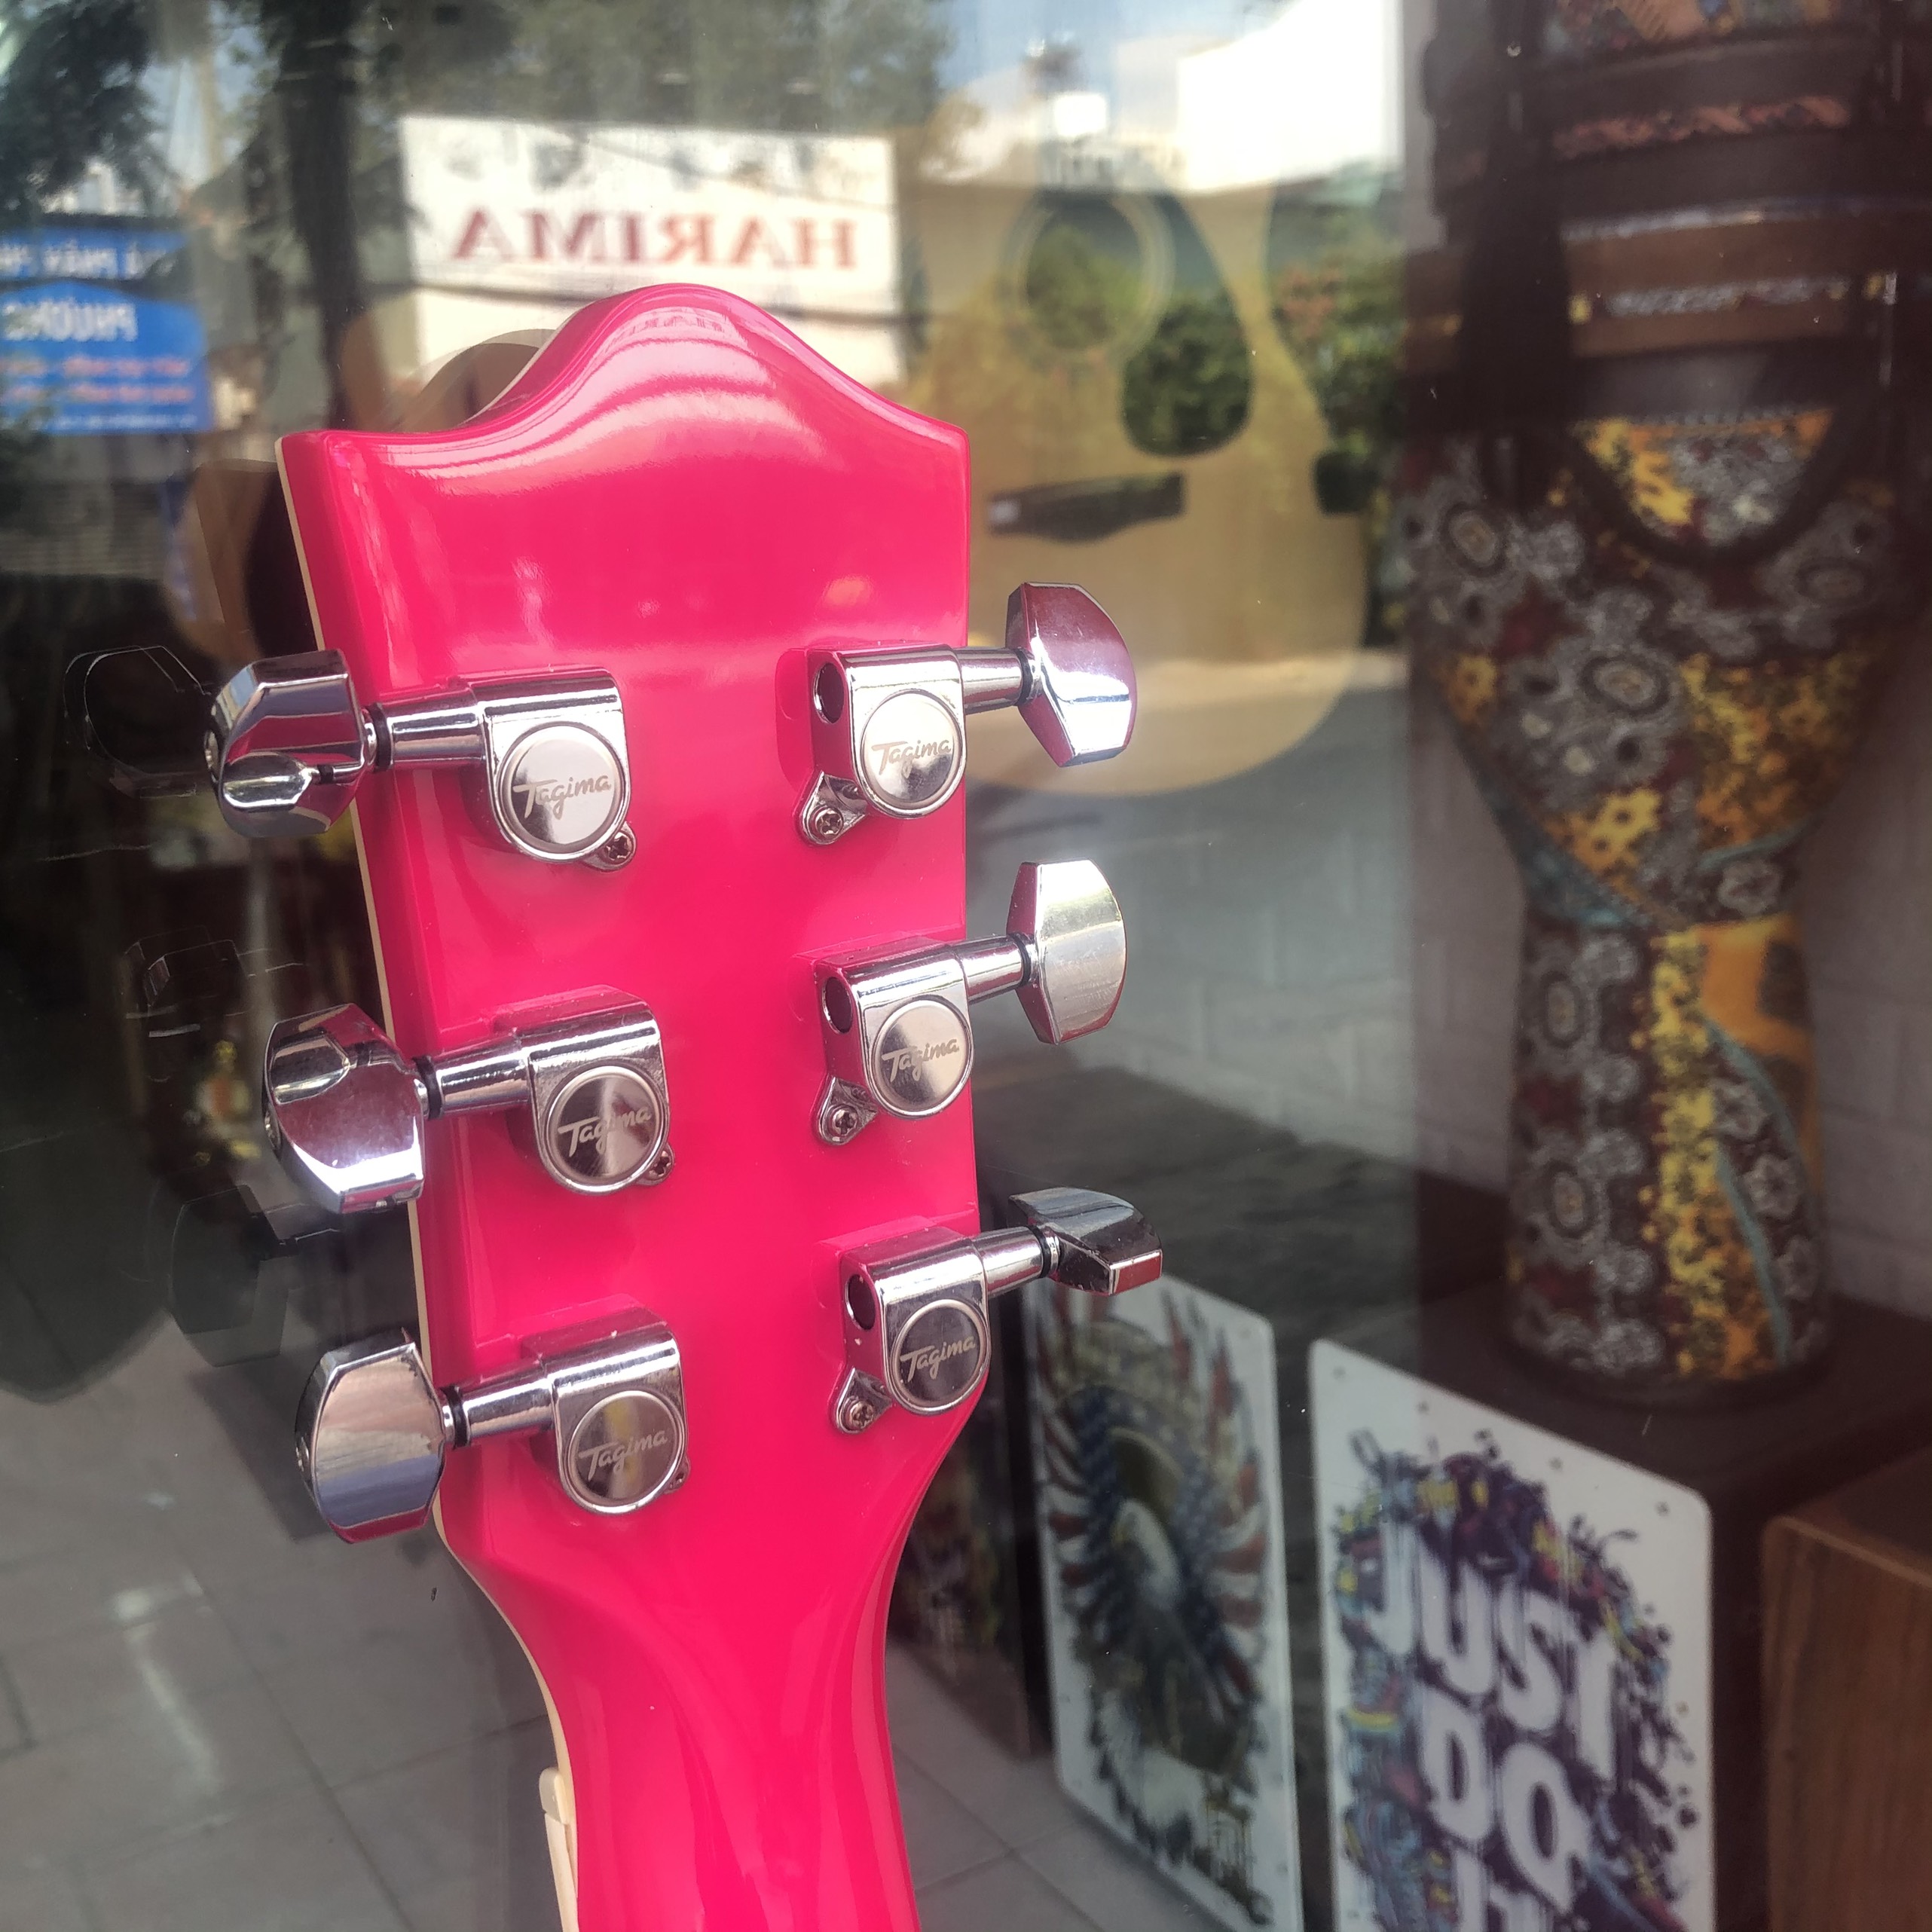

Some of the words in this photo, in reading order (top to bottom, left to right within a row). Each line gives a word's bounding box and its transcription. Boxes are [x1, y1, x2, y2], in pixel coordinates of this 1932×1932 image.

[870, 739, 952, 779] Tagima
[512, 775, 613, 821] Tagima
[881, 1038, 960, 1083] Tagima
[557, 1106, 652, 1158] Tagima
[900, 1335, 976, 1383] Tagima
[578, 1430, 668, 1482] Tagima
[1356, 1518, 1624, 1781] JUST
[1415, 1680, 1594, 1915] DO
